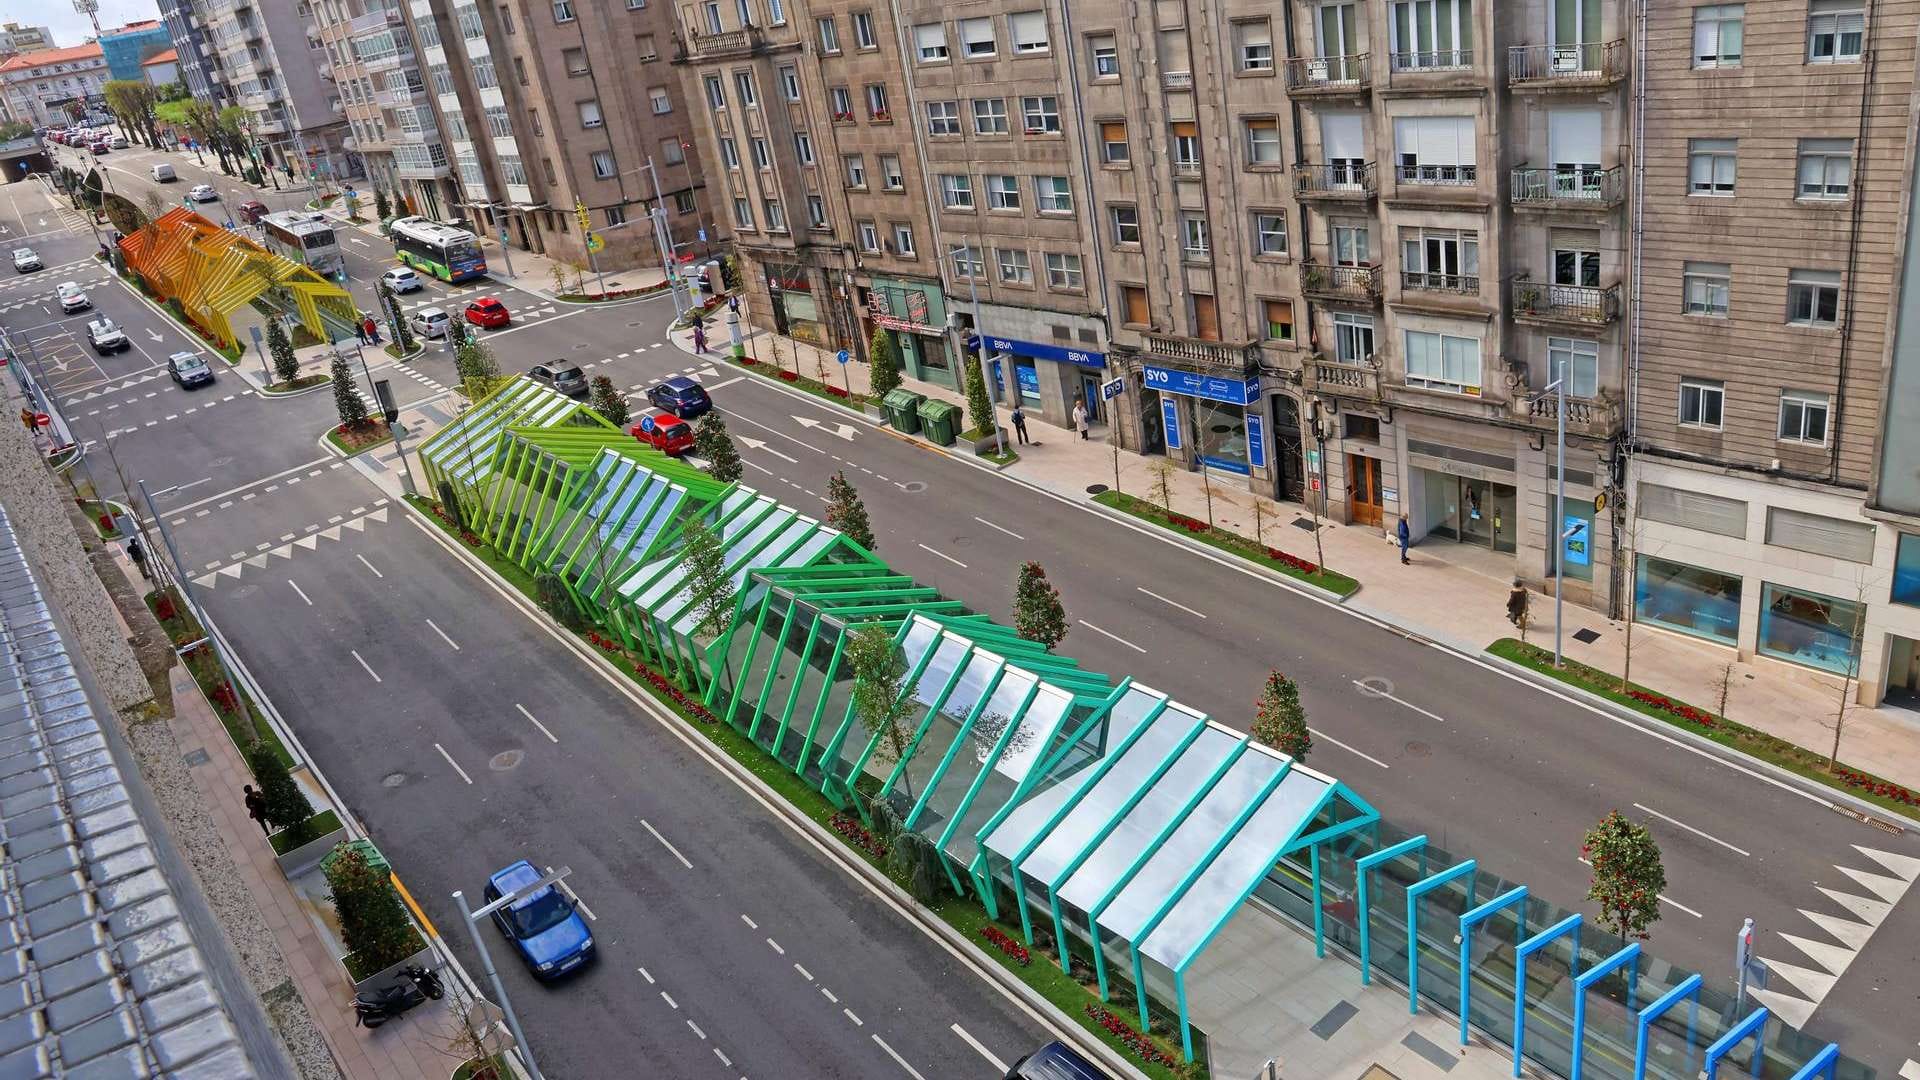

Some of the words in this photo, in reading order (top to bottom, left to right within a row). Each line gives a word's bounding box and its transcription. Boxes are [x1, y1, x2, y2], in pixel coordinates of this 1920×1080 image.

[994, 340, 1013, 350] BBVA
[1068, 352, 1090, 363] BBVA
[1147, 369, 1169, 383] SYO
[1105, 382, 1121, 395] SYO
[1246, 383, 1259, 394] SYO
